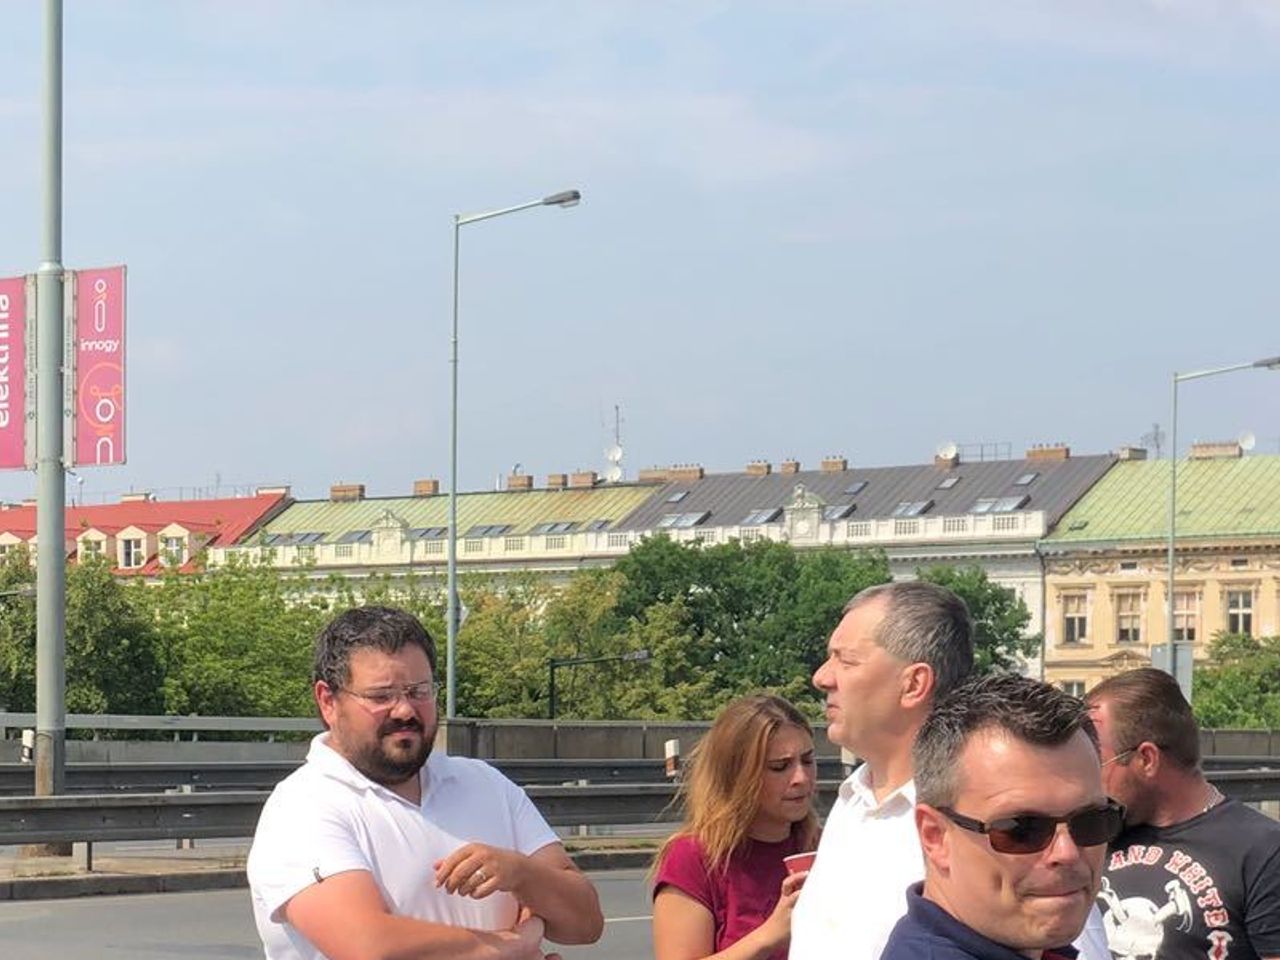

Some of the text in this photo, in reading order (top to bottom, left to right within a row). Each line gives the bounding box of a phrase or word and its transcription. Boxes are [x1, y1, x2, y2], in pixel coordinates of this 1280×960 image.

[80, 337, 120, 352] innogy
[1108, 844, 1229, 928] AND WHITE
